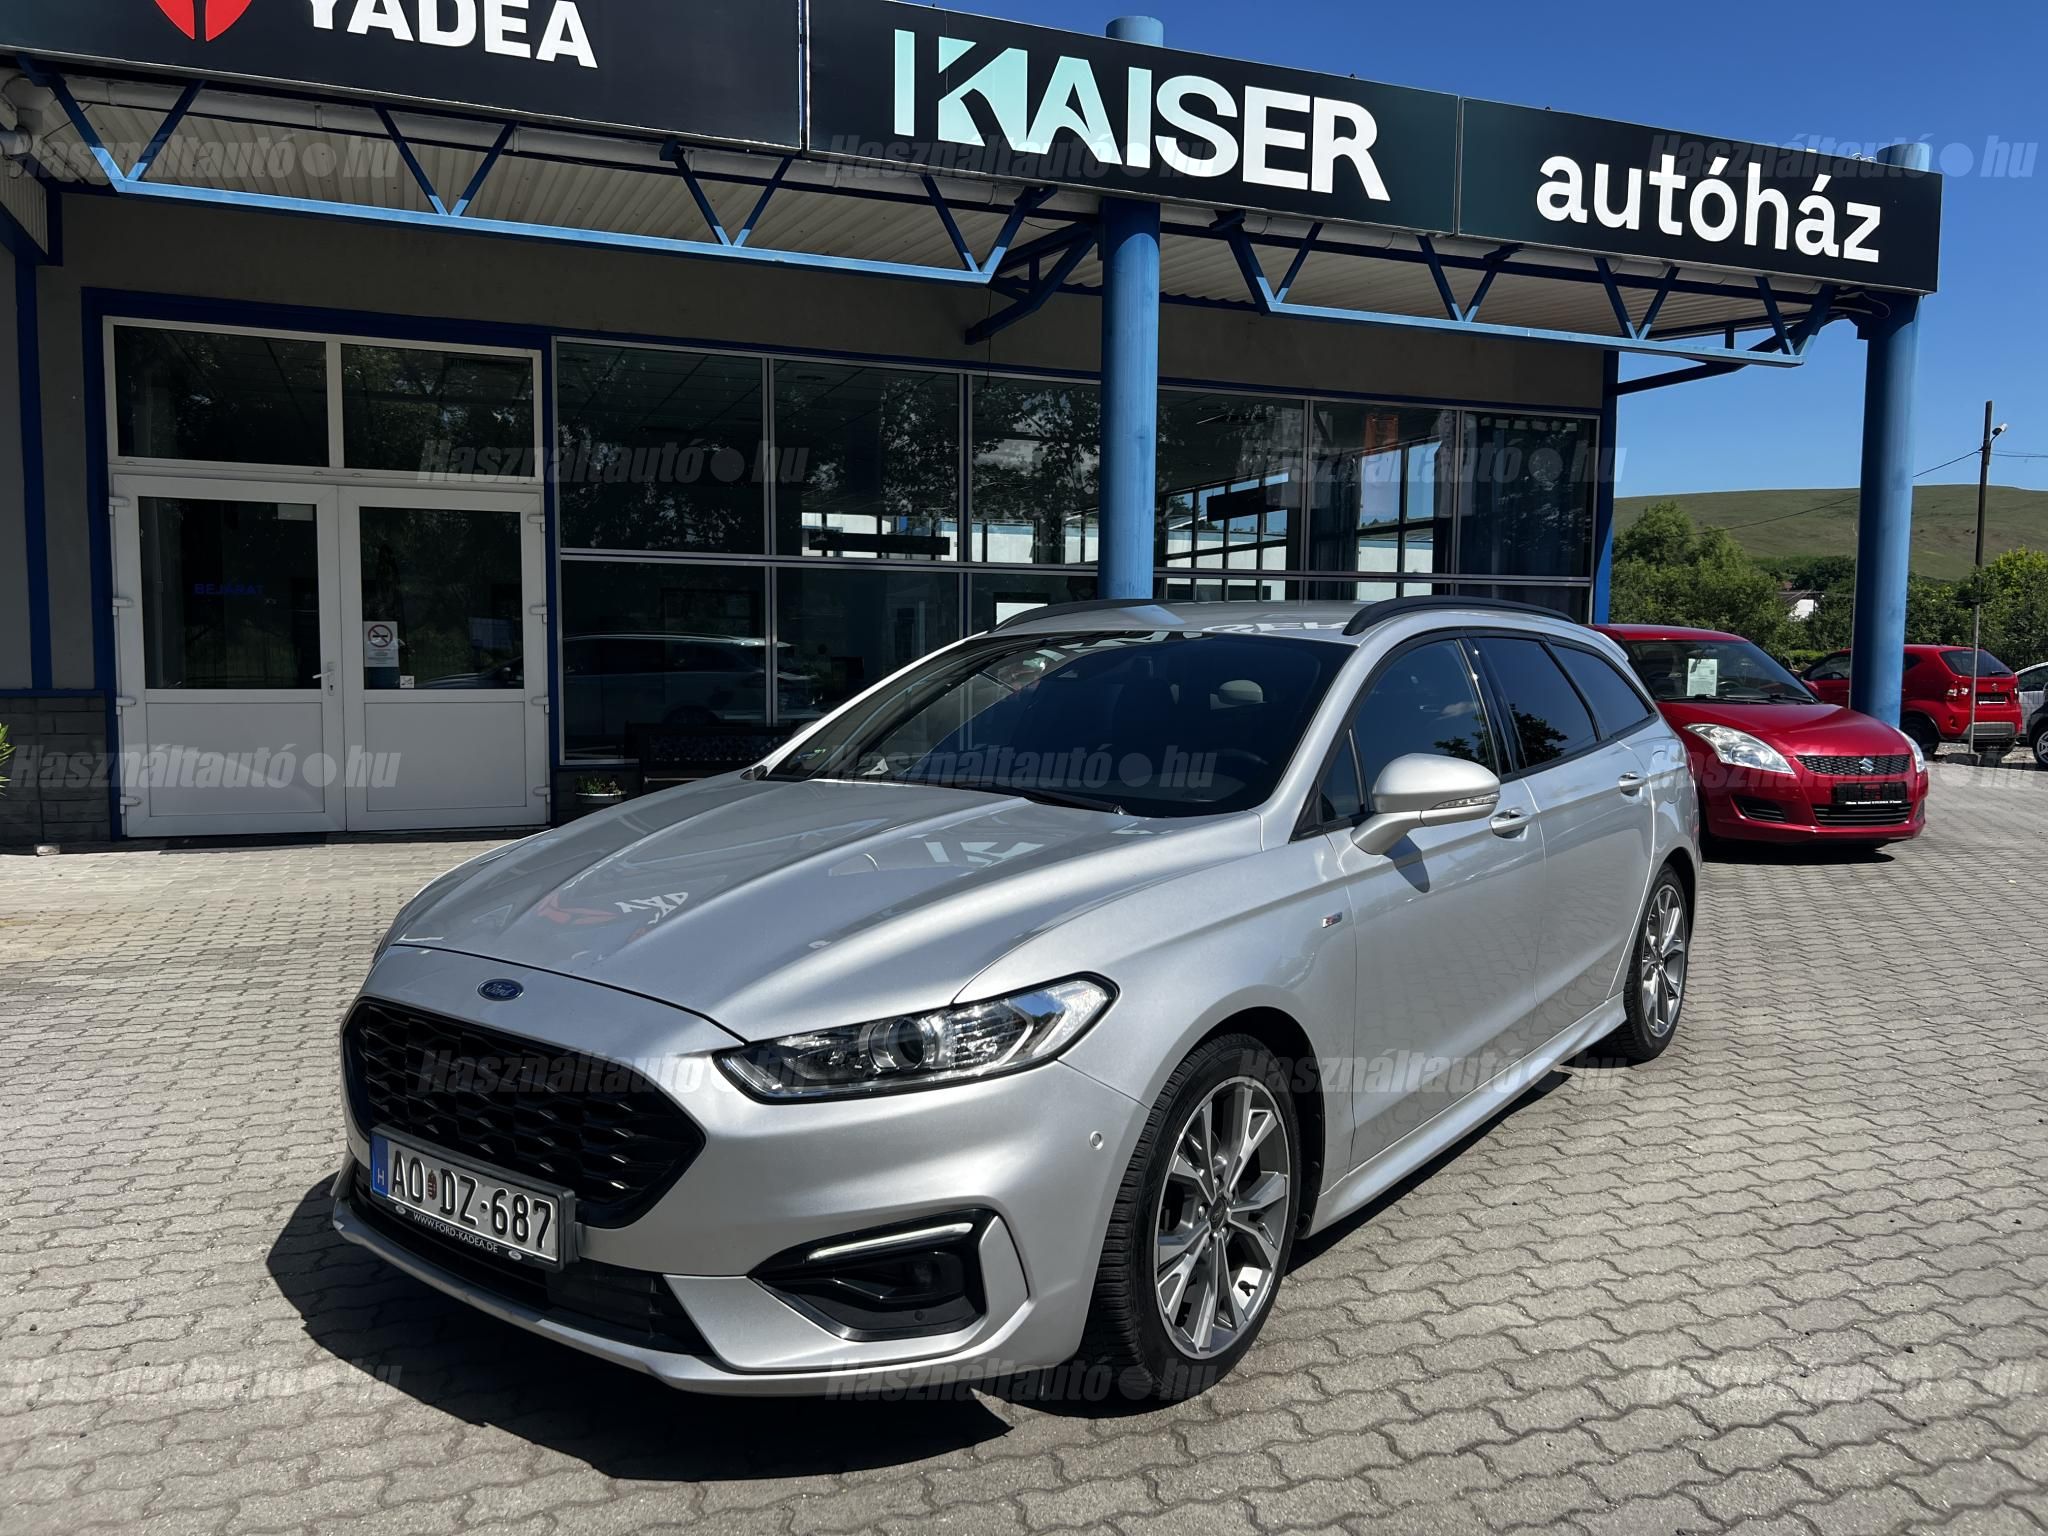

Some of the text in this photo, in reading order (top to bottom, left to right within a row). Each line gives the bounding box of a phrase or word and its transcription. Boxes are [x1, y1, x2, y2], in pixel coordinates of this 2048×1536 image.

[1536, 154, 1881, 263] autóház
[377, 1167, 385, 1185] H
[413, 1212, 498, 1253] WWW.FORD-KADEA.DE
